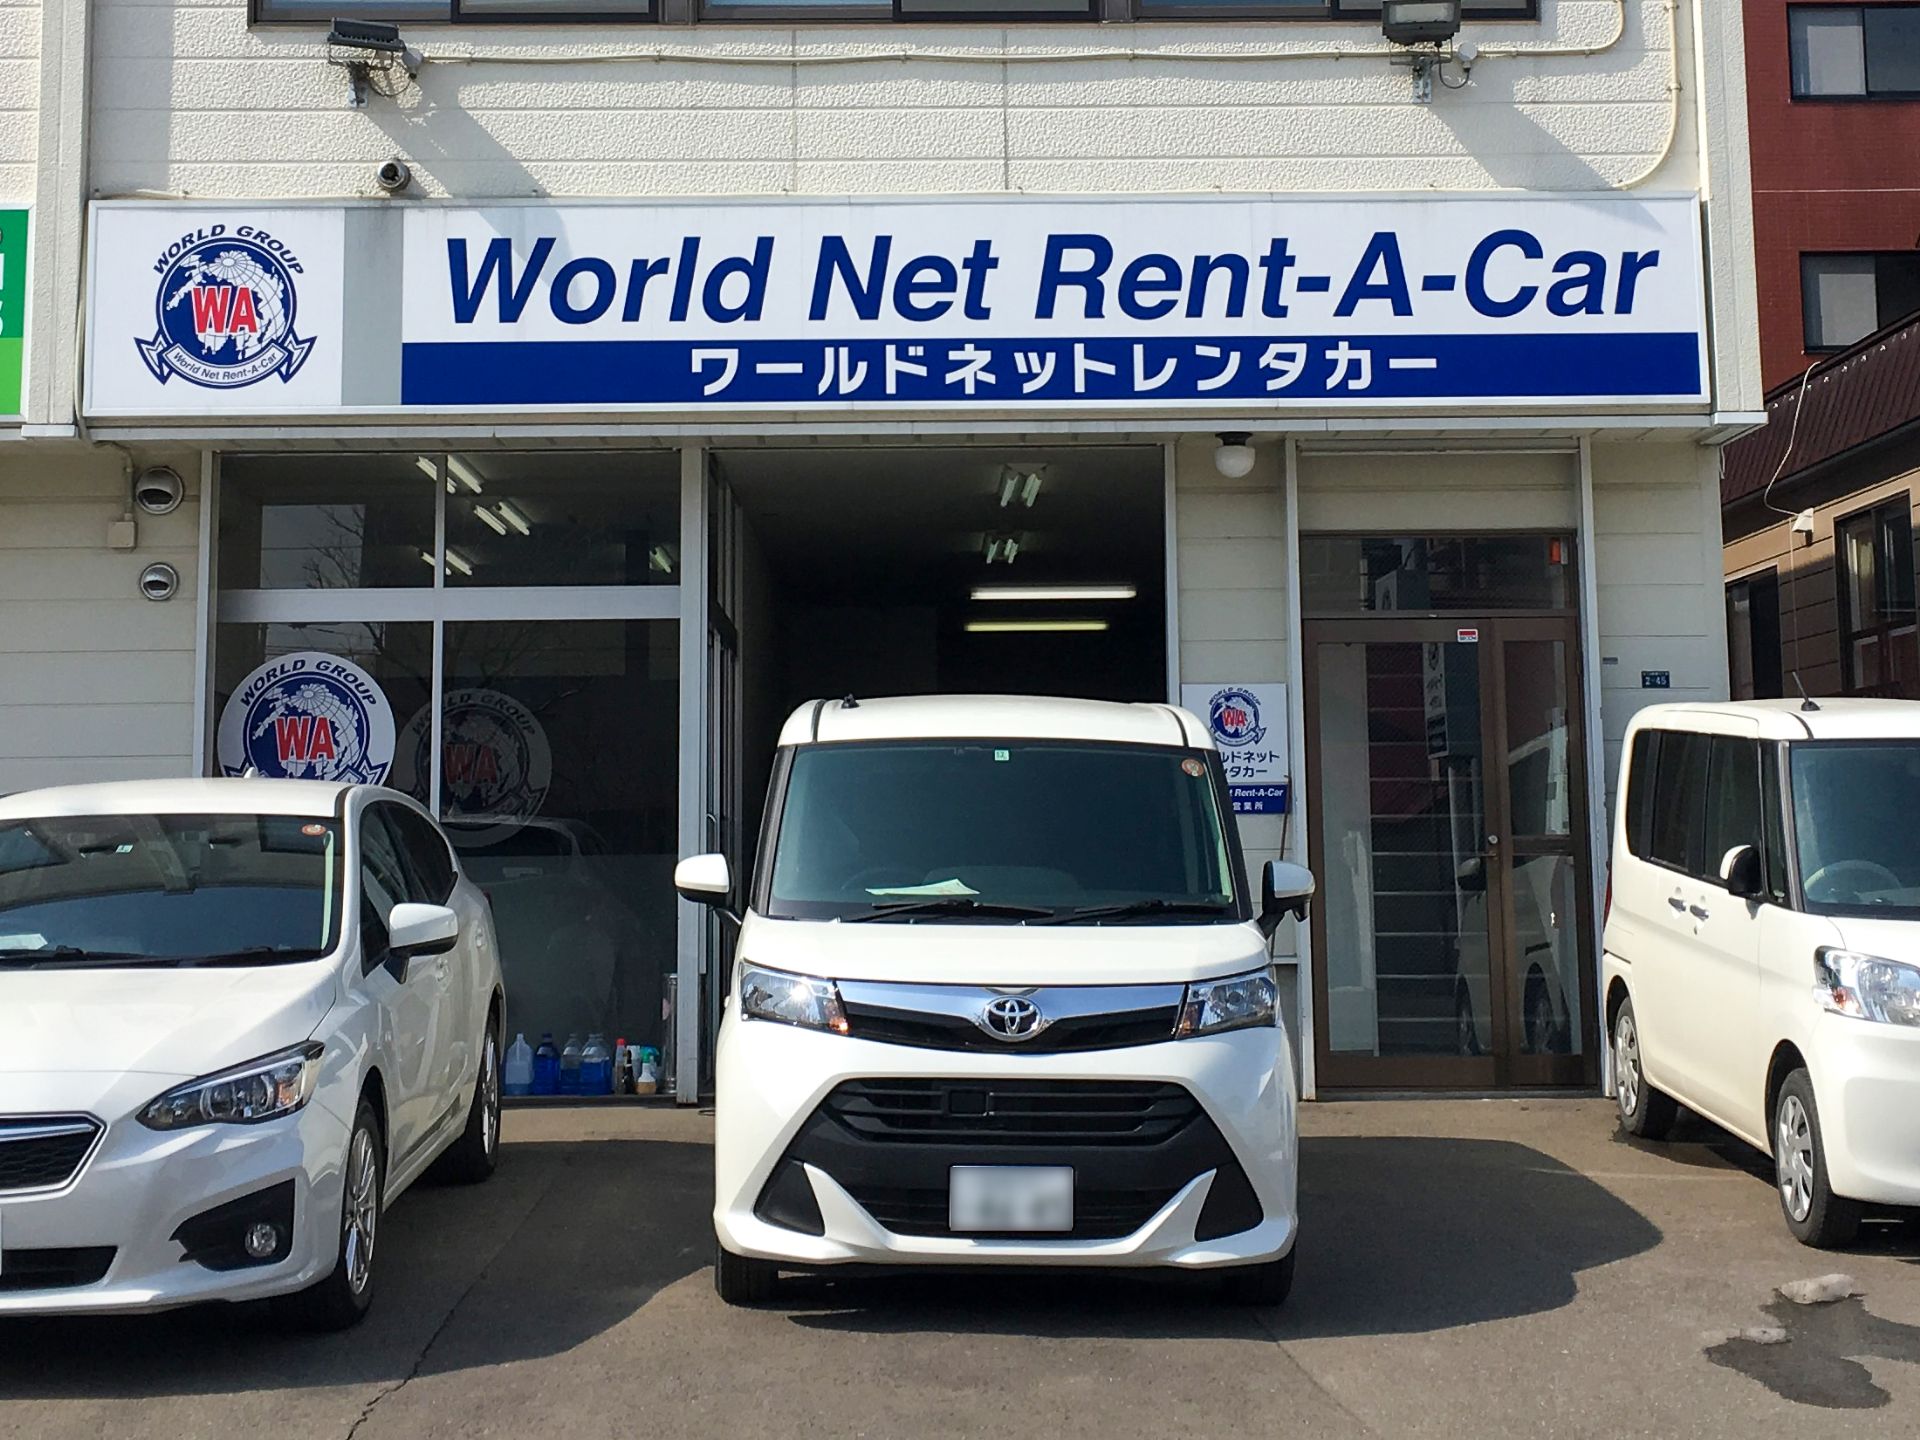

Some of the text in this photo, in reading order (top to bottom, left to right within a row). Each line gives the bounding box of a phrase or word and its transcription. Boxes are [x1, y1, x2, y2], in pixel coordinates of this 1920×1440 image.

[153, 224, 304, 275] WORLD GROUP
[446, 229, 1660, 325] World Net Rent-A-Car
[191, 286, 258, 334] WA
[173, 352, 278, 380] World Net Rent-A-Car
[691, 340, 1438, 396] ワールドネットレンタカー
[239, 659, 377, 709] WORLD GROUP
[276, 716, 335, 761] WA
[1222, 709, 1246, 726] WA
[444, 743, 497, 785] WA
[1221, 750, 1280, 763] ルドネット
[1234, 788, 1284, 797] Rent-A-Car
